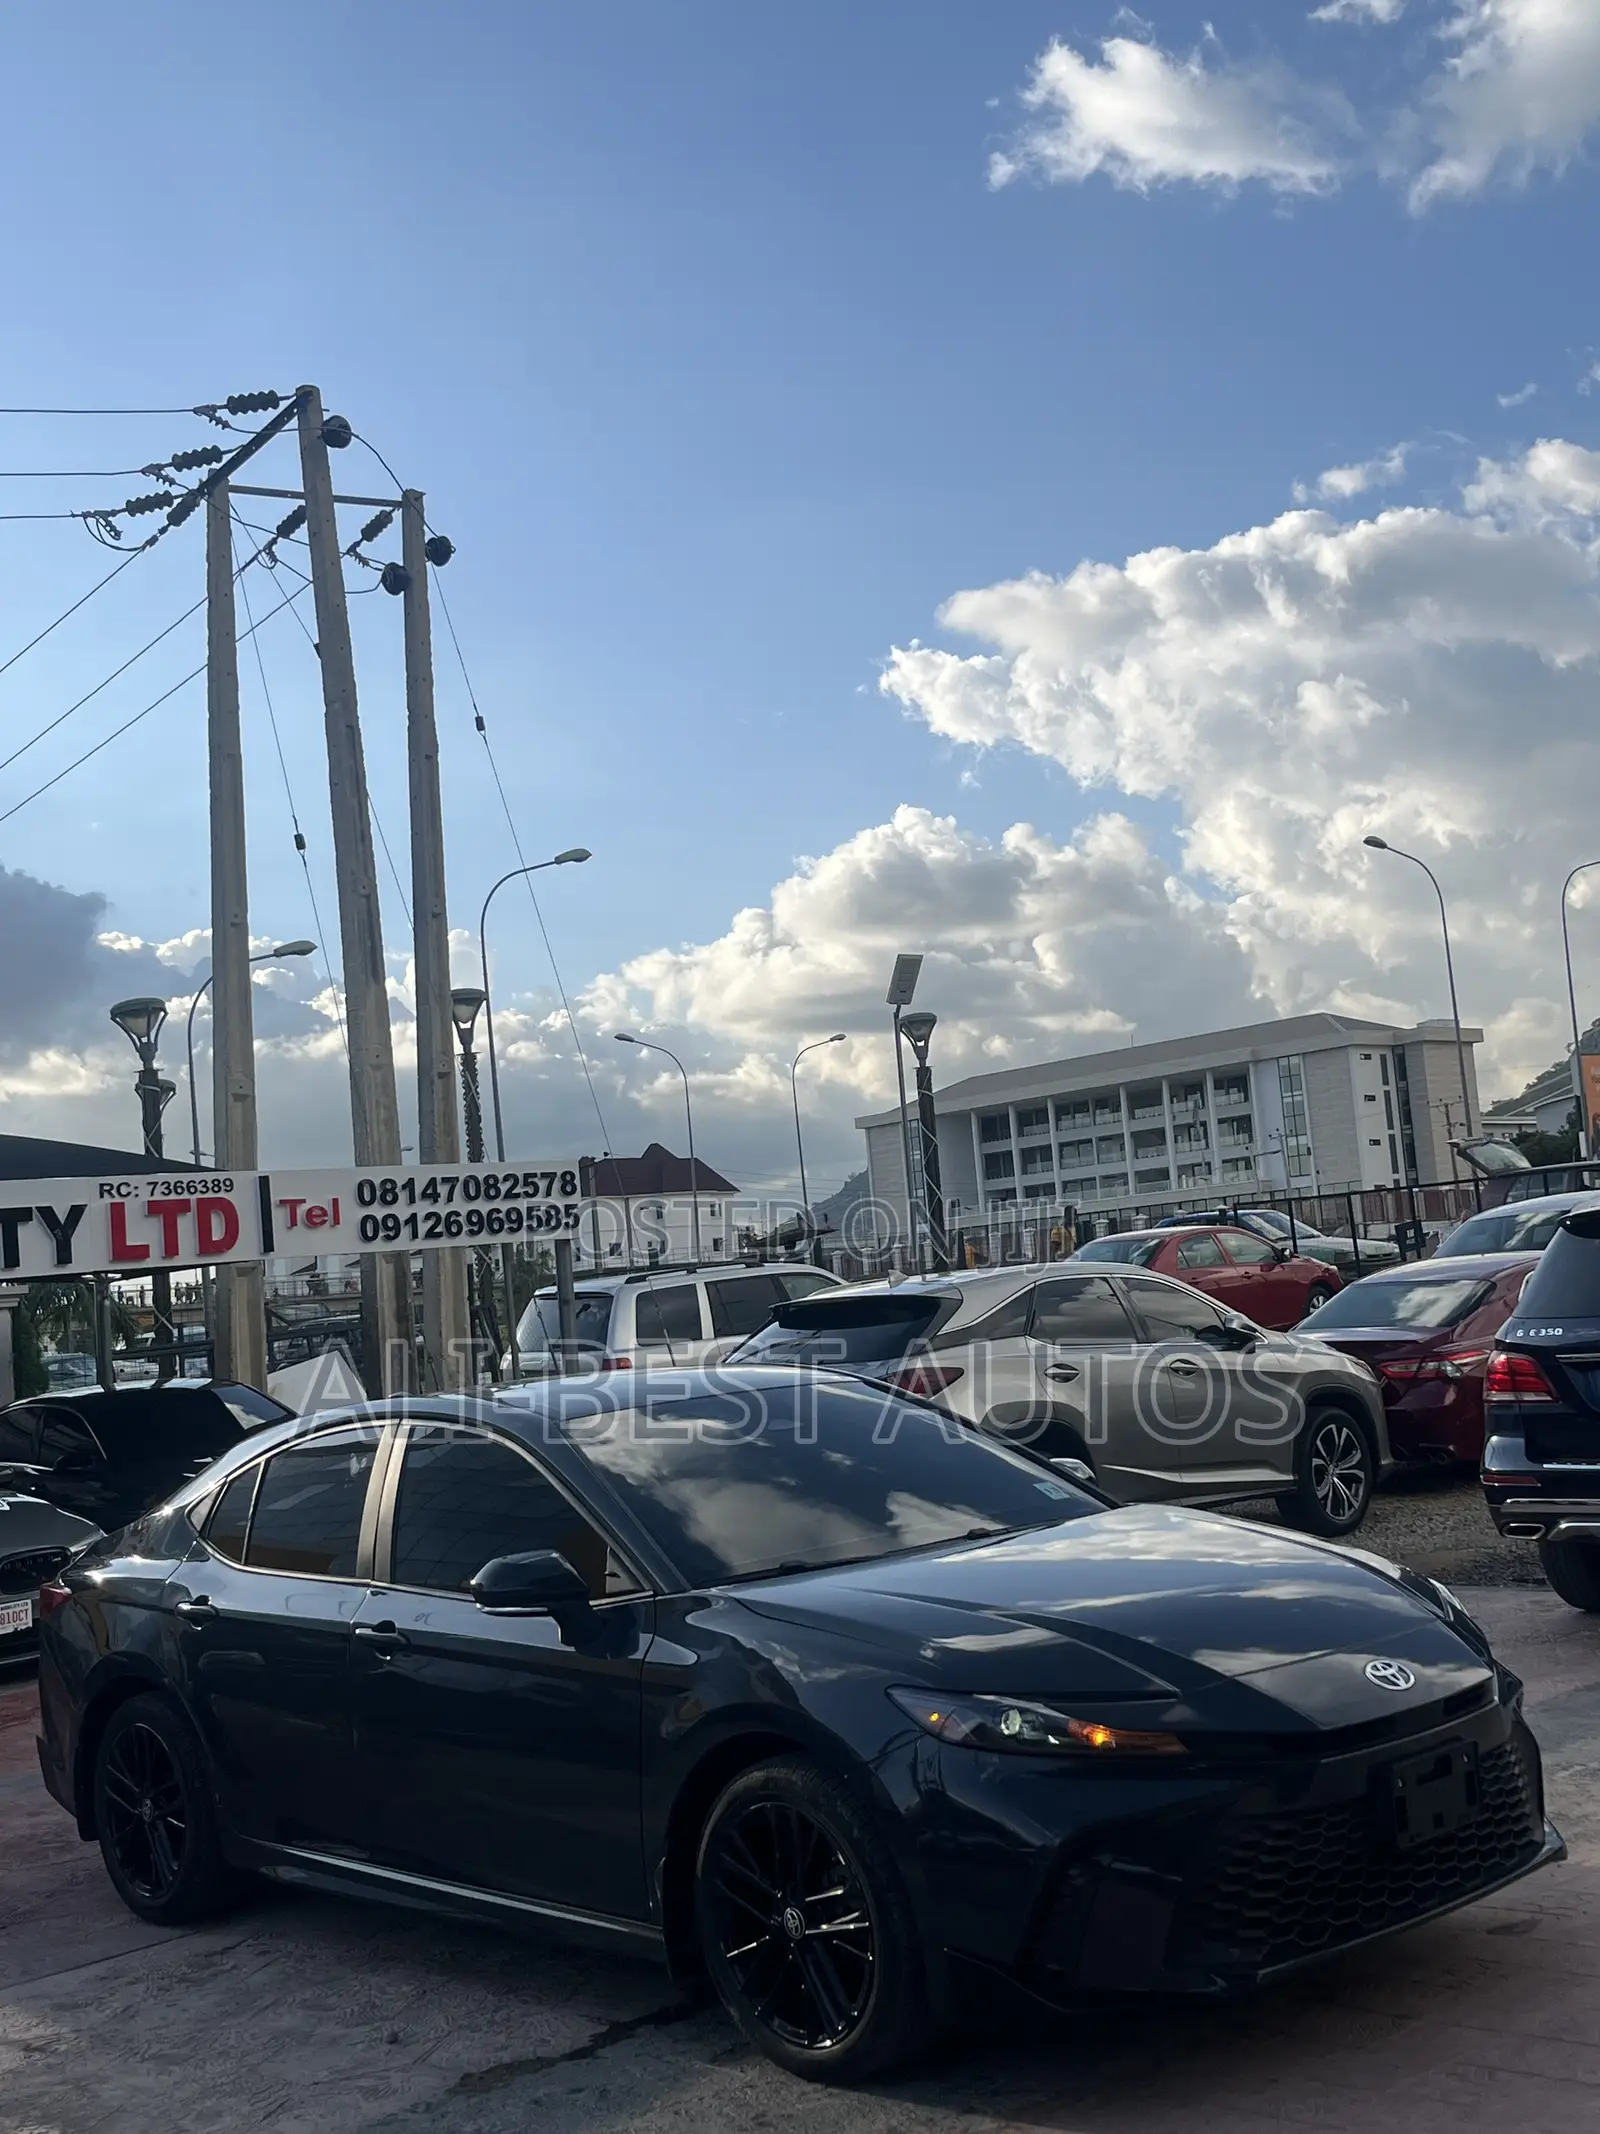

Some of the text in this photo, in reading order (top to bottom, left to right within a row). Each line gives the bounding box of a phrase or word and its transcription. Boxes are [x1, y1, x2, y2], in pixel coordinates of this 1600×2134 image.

[98, 1177, 235, 1199] RC: 7366389
[357, 1170, 578, 1206] 08147082578
[109, 1196, 240, 1262] LTD
[276, 1198, 341, 1229] Tel
[359, 1203, 581, 1242] 09126969585
